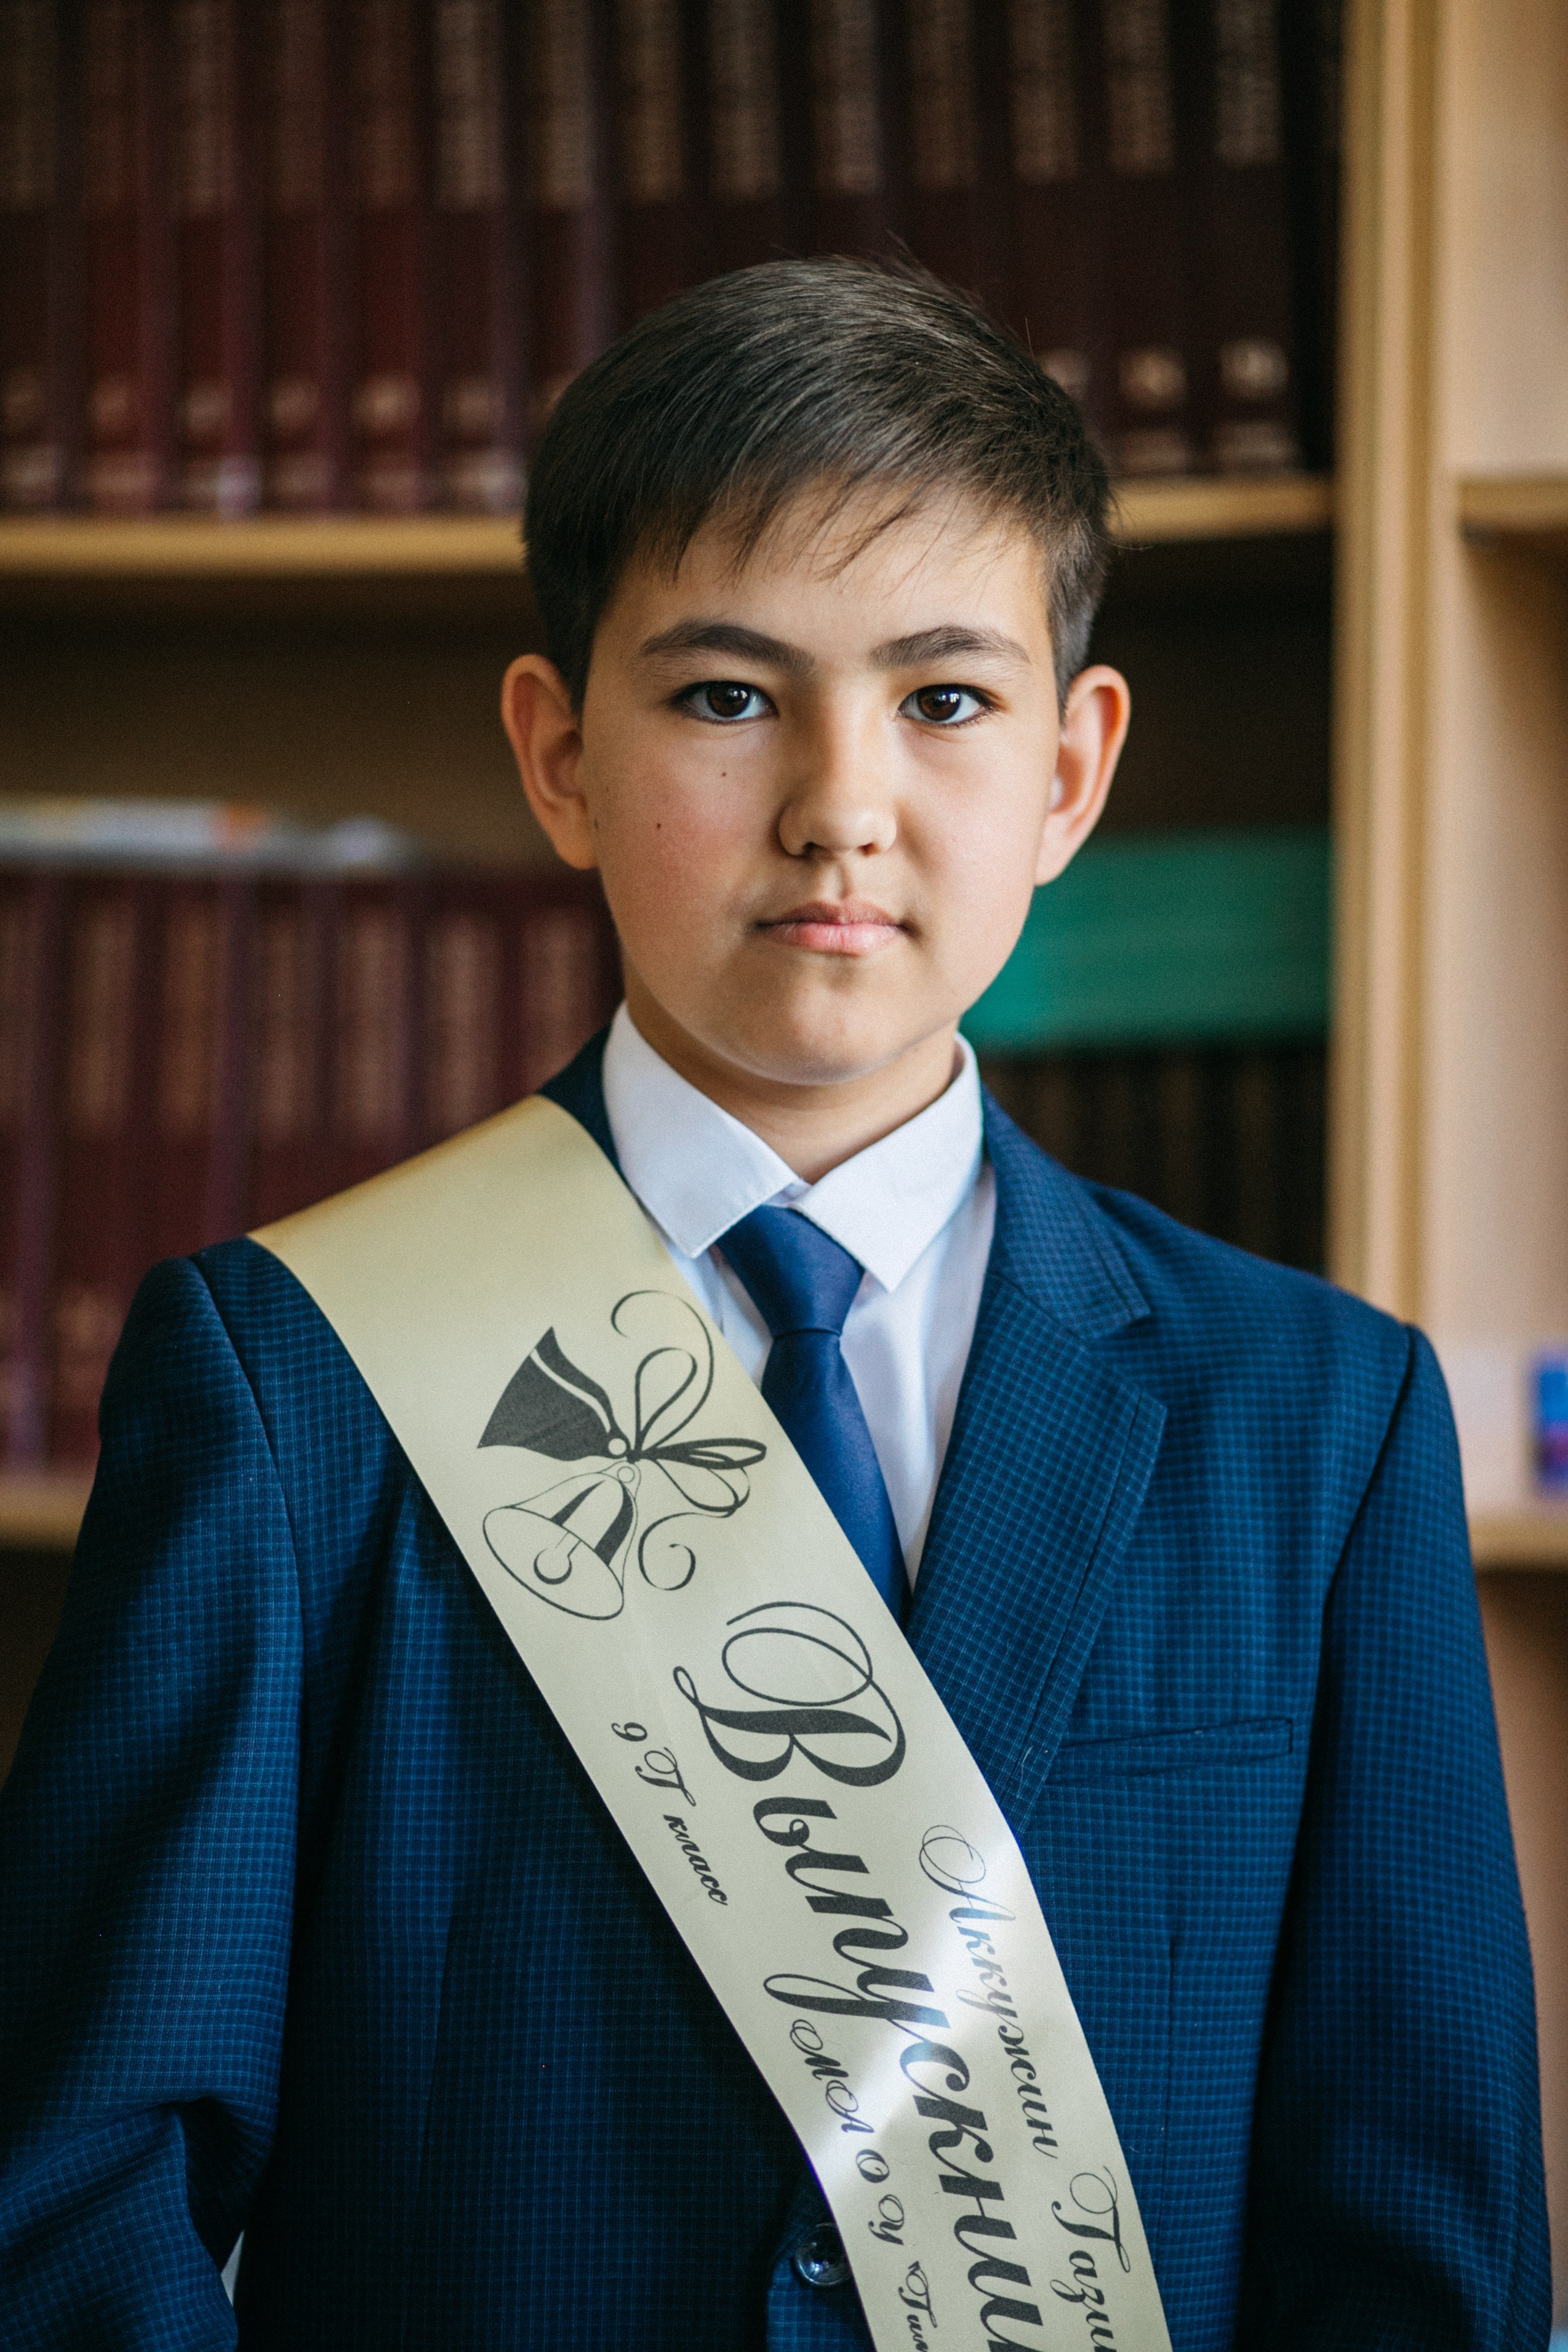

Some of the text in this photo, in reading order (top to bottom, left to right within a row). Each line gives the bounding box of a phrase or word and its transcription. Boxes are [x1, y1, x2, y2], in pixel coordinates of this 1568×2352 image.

[662, 1814, 728, 1906] класс
[673, 1600, 1046, 2352] Выпускни
[919, 1824, 1131, 2352] Аккужин Гази
